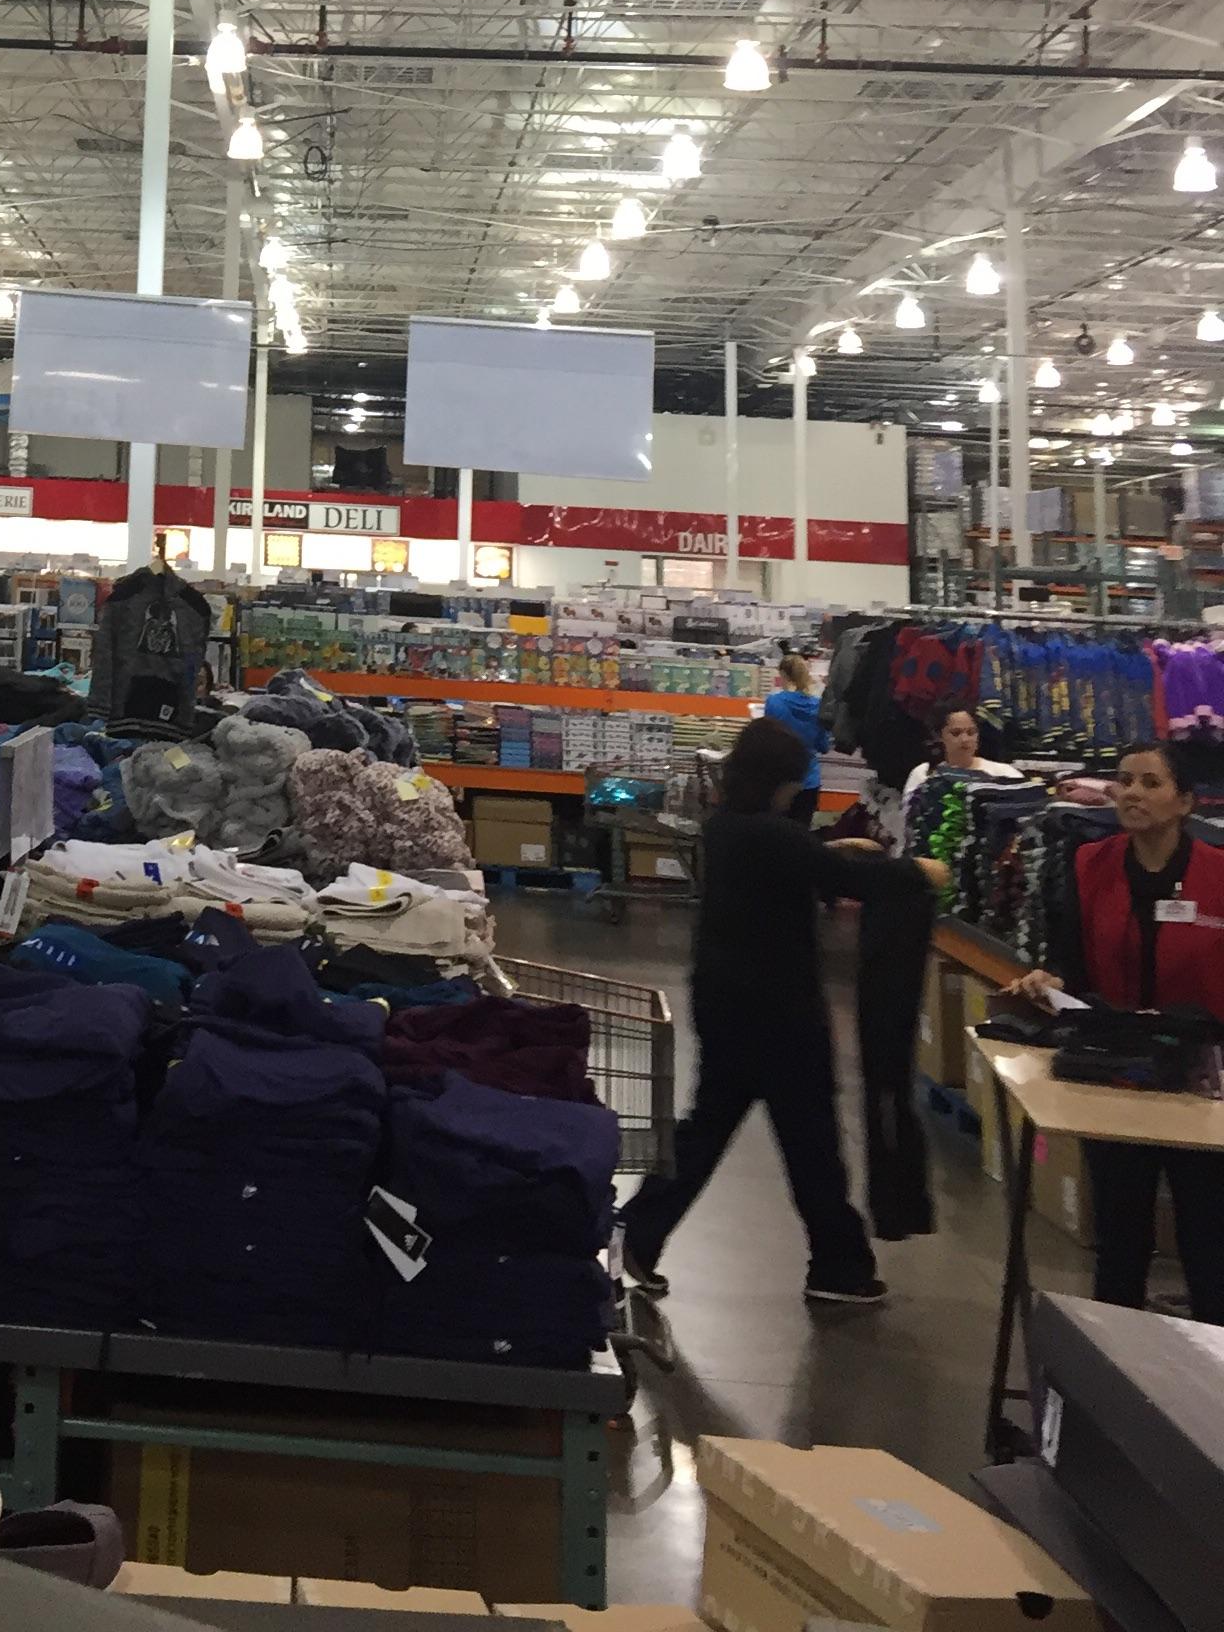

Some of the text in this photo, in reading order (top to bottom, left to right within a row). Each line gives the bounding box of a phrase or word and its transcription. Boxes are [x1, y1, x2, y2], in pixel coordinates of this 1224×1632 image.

[228, 501, 308, 519] KIRLAND
[323, 506, 384, 531] DELI
[678, 531, 743, 554] DAIR
